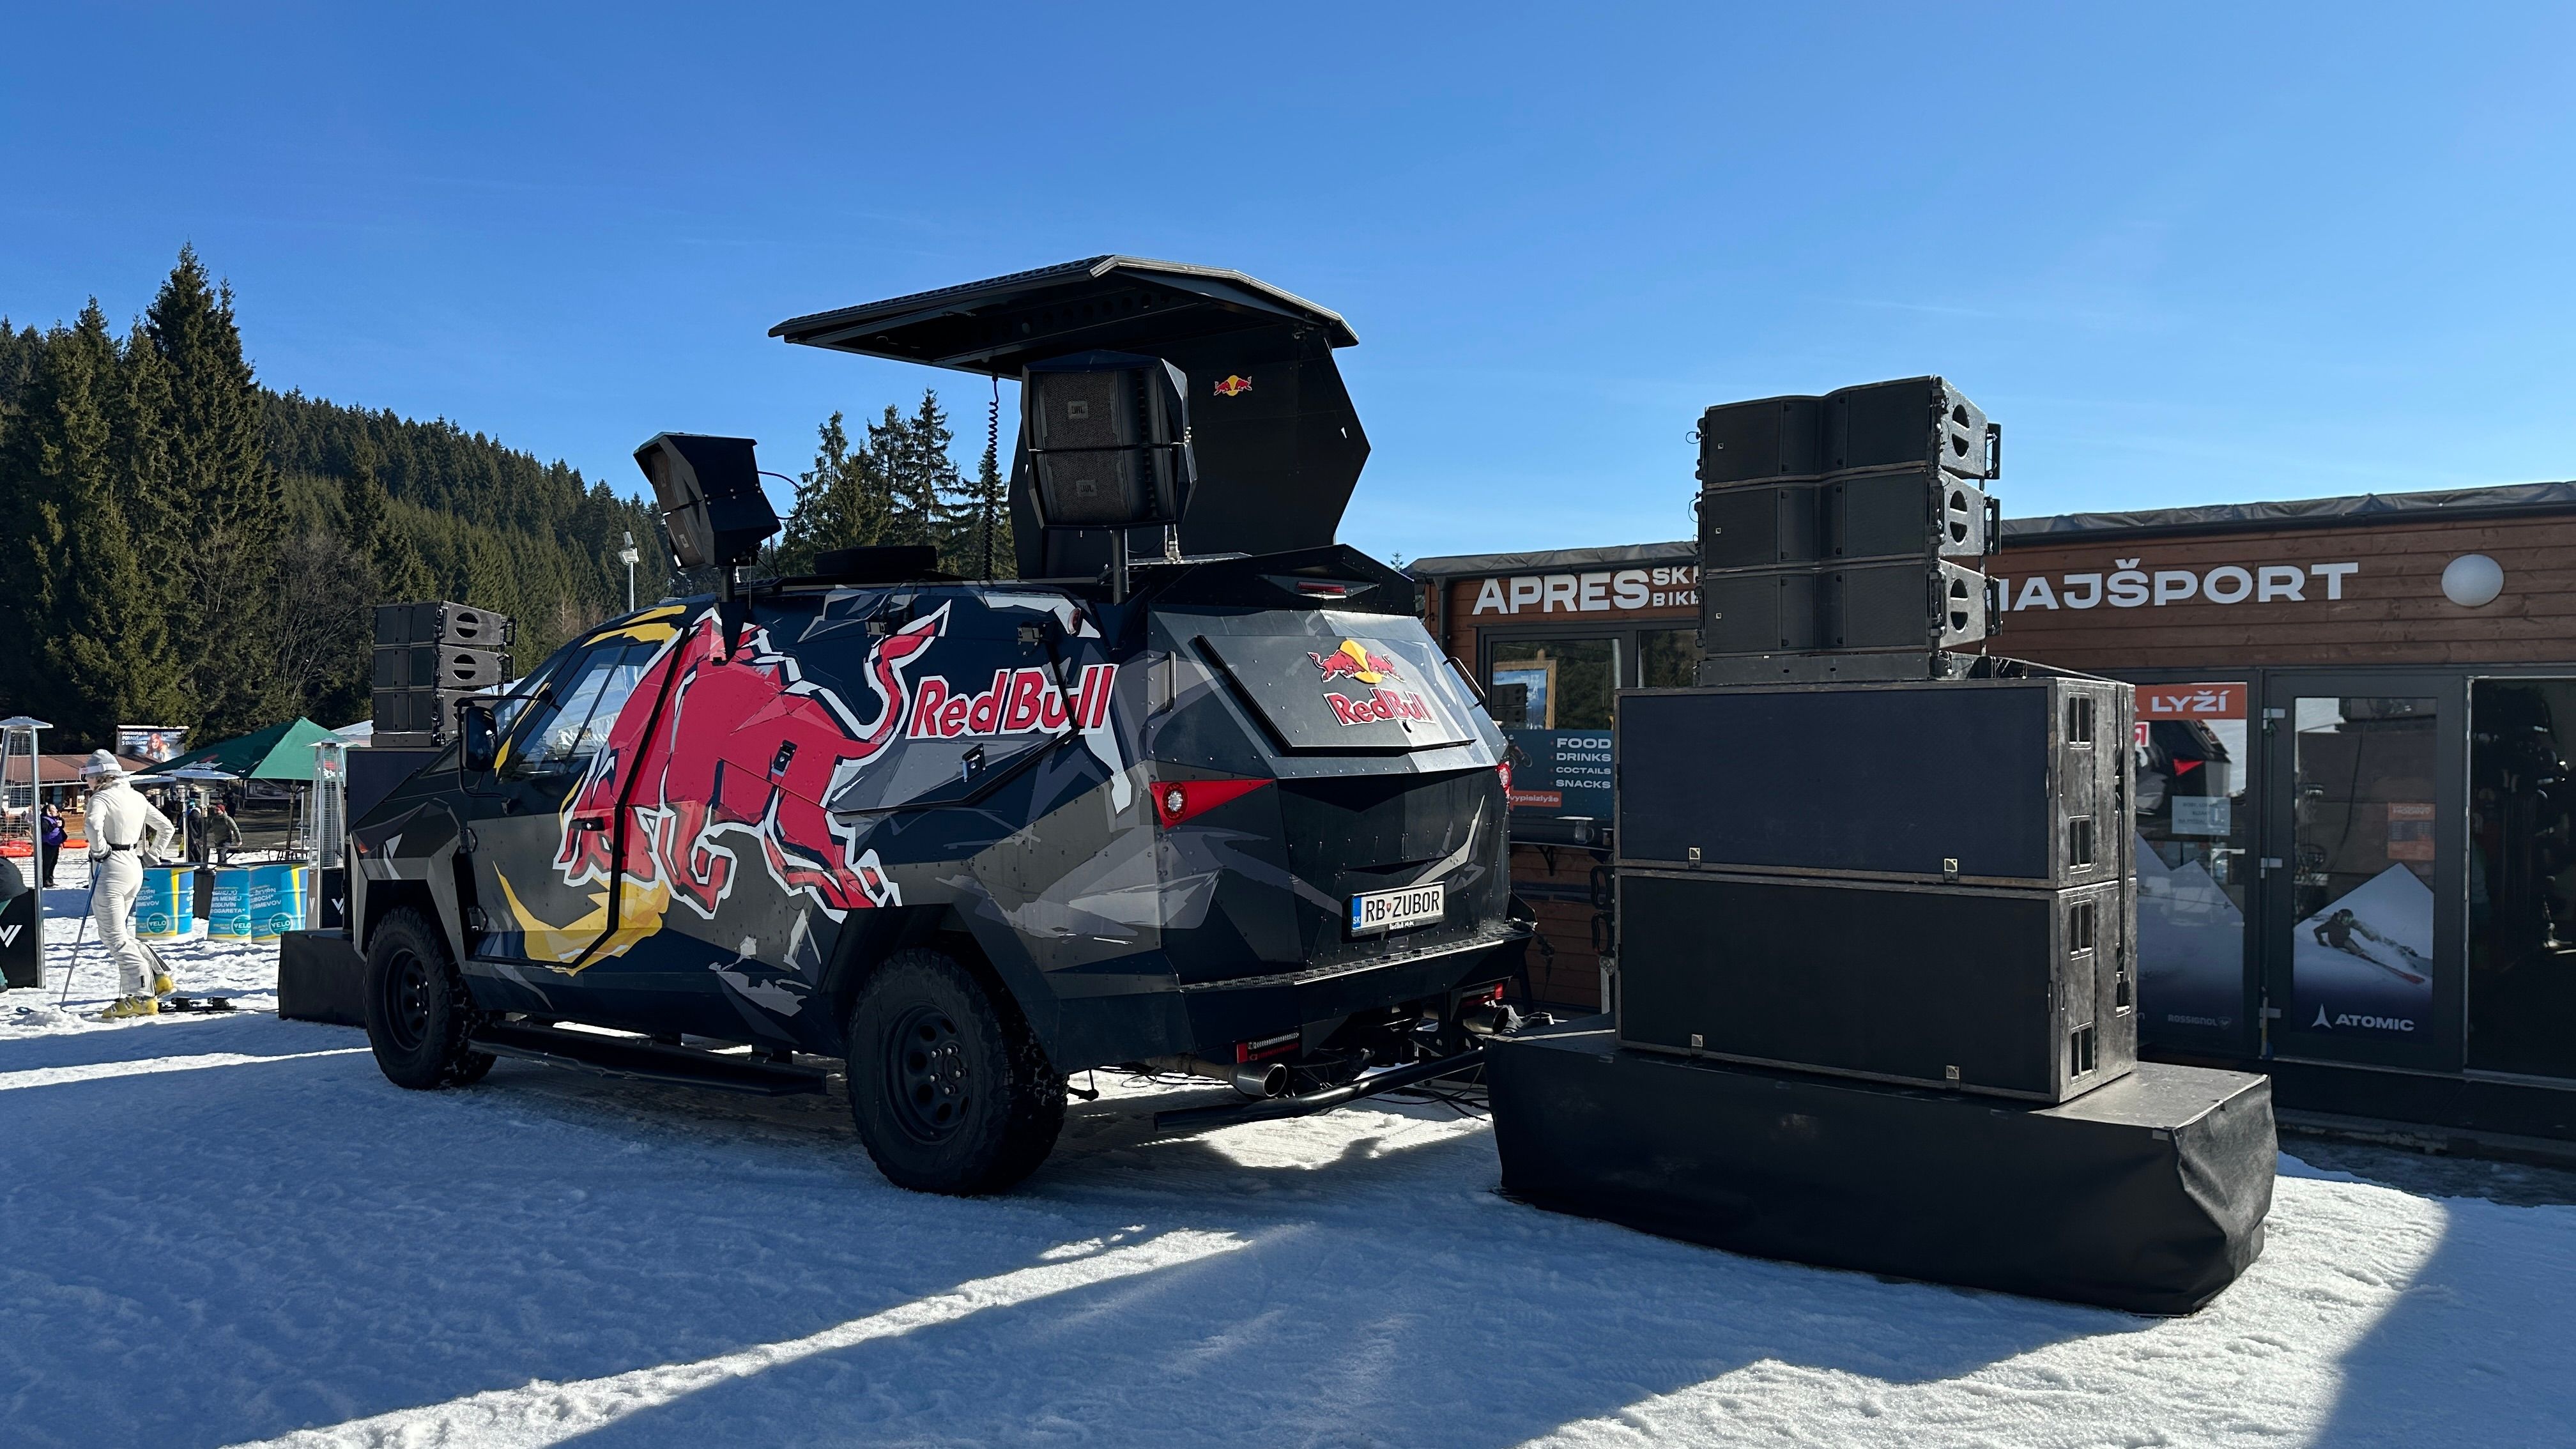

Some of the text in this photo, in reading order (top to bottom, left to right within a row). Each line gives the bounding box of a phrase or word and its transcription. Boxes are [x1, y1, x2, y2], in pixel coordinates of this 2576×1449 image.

[1652, 566, 1699, 586] SKI
[1472, 569, 1650, 615] APRES
[910, 665, 1116, 737] Red Bull
[1326, 688, 1434, 724] Red Bull
[2152, 689, 2231, 712] LYŽÍ
[1556, 738, 1612, 749] FOOD
[1556, 753, 1612, 762] DRINKS
[1556, 767, 1612, 775] COCTAILS
[1556, 779, 1611, 789] SNACKS
[1365, 891, 1440, 923] RB ZUBOR
[272, 920, 291, 928] VELO
[1353, 916, 1361, 924] SK
[2335, 1013, 2415, 1032] ATOMIC
